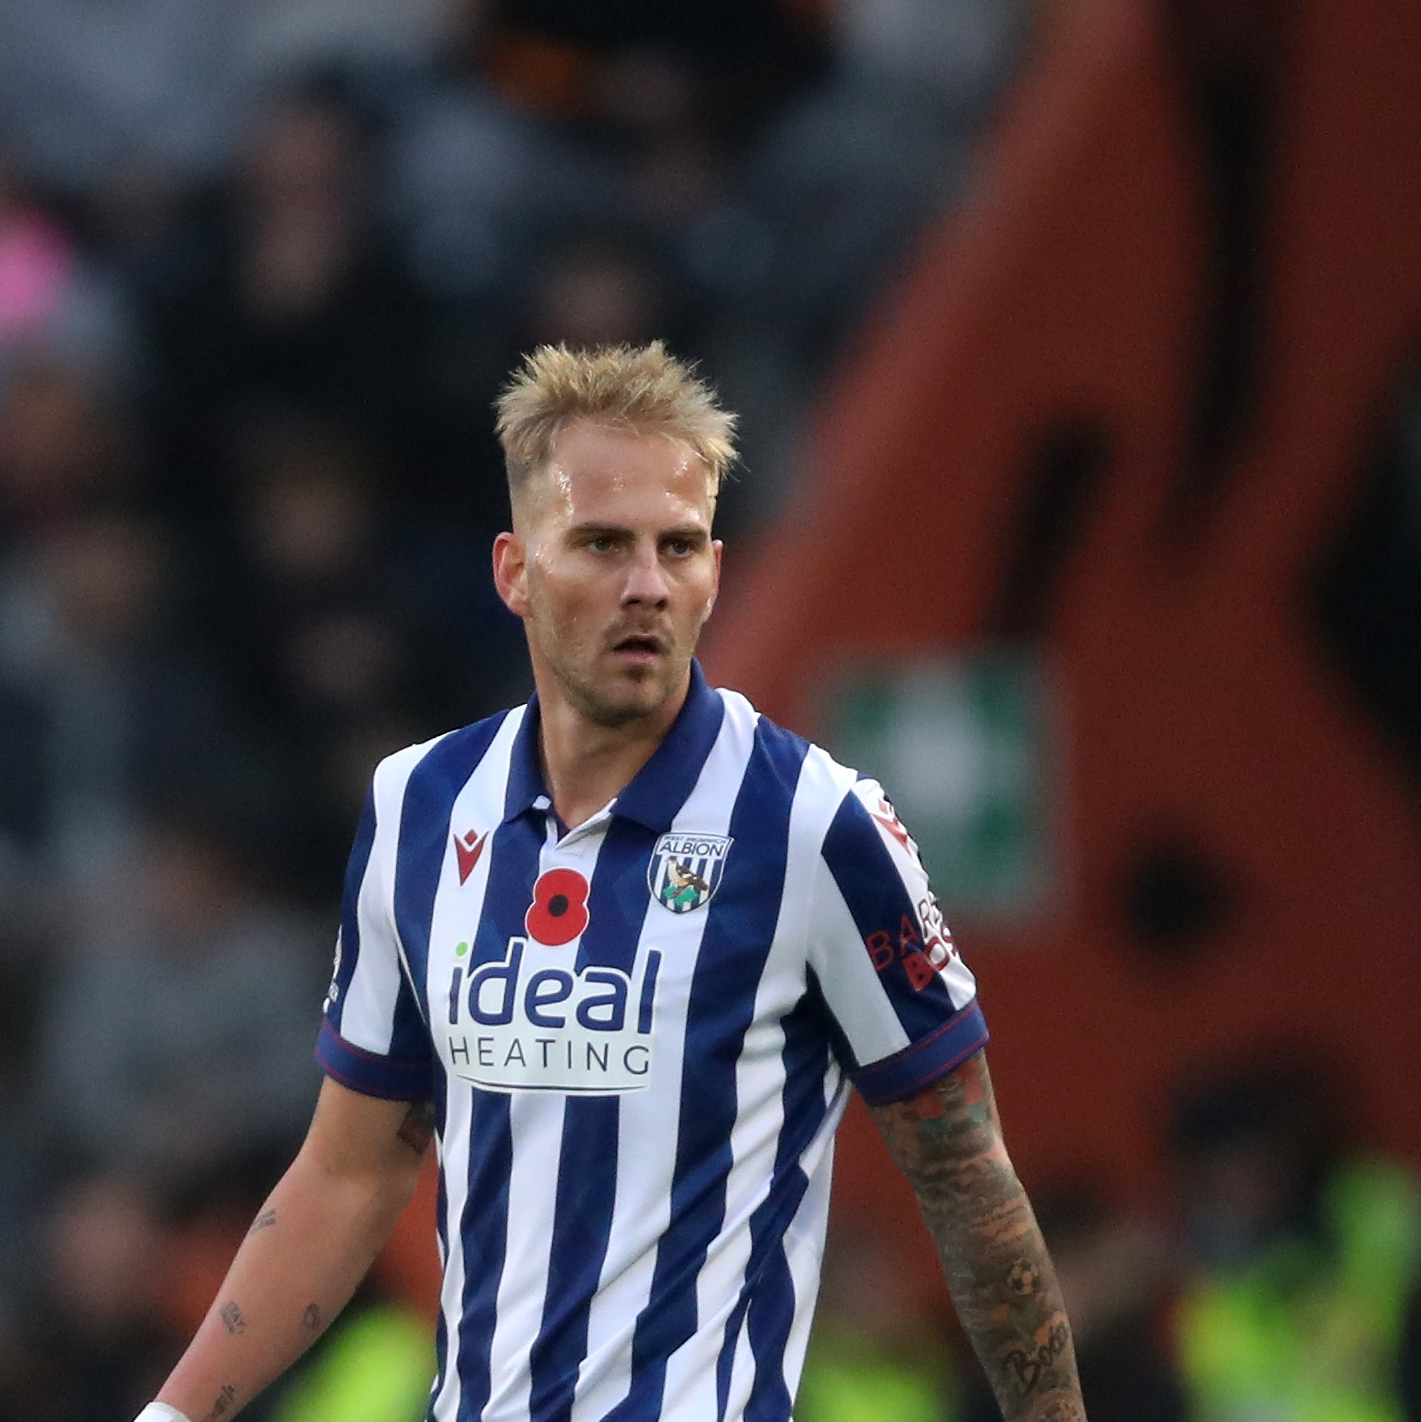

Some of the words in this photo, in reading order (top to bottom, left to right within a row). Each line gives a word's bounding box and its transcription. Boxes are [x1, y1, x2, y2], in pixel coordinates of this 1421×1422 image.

[659, 841, 724, 856] ALBION
[449, 941, 662, 1034] ideal
[449, 1036, 650, 1075] HEATING
